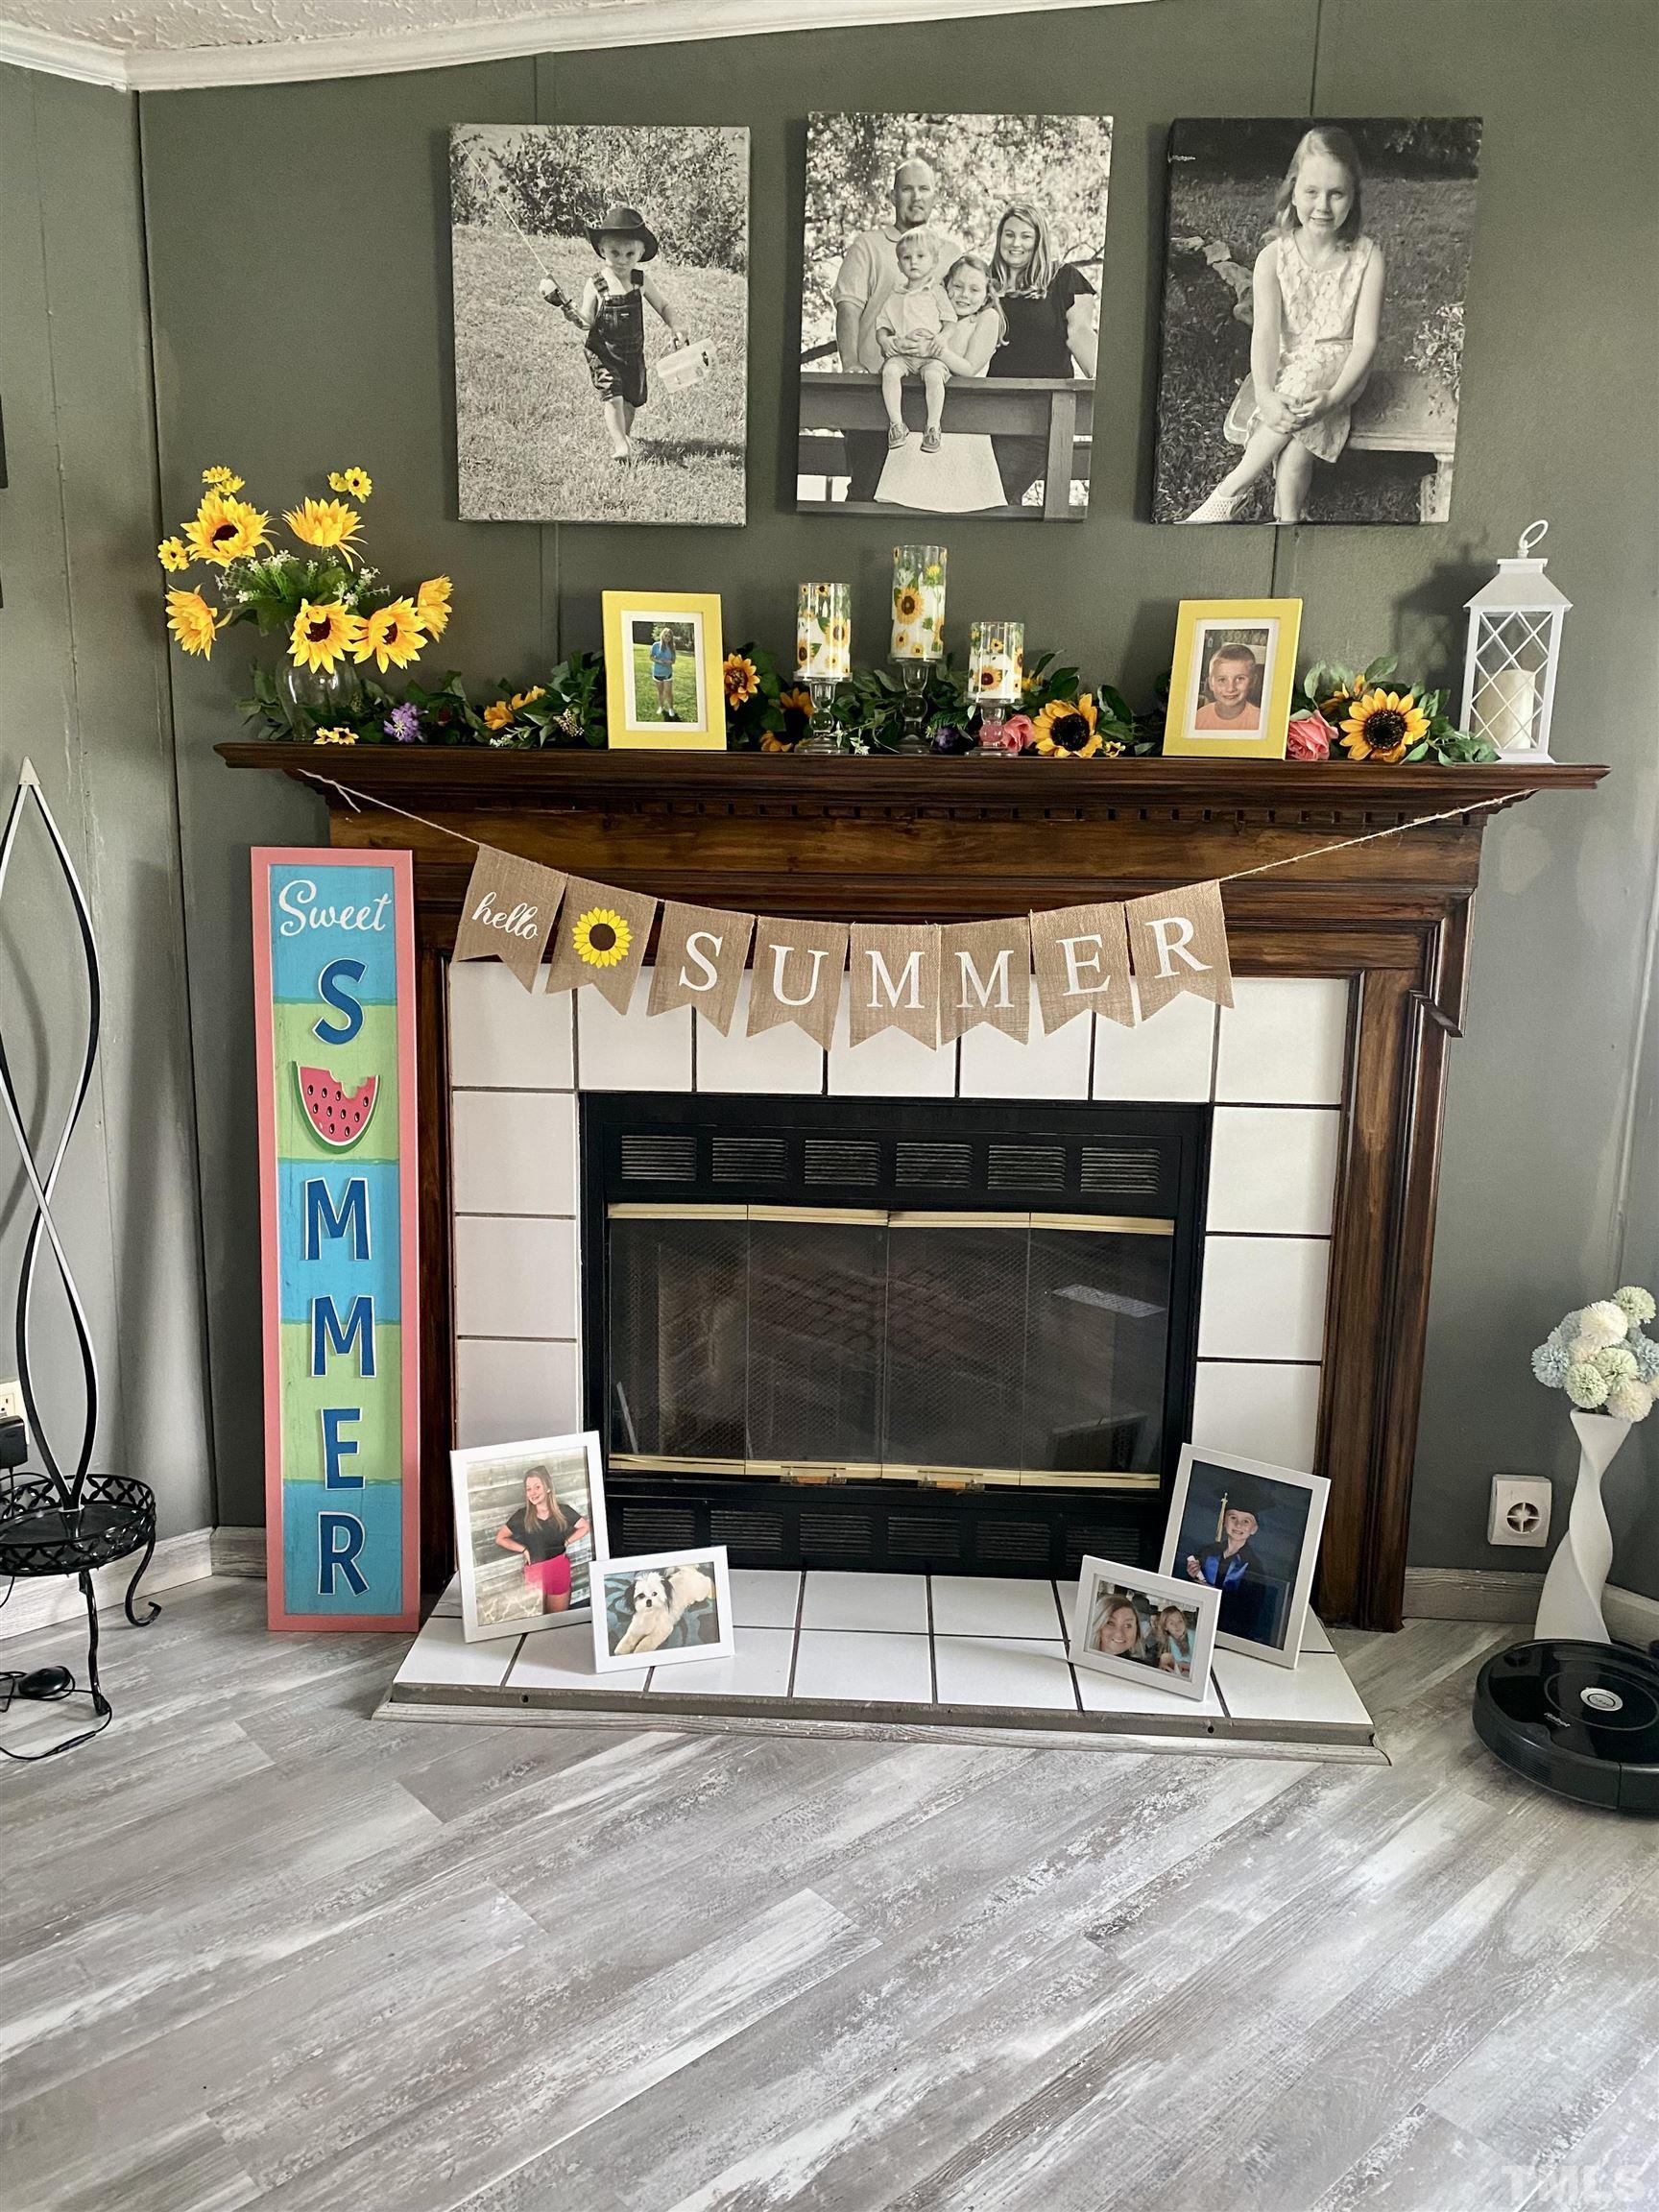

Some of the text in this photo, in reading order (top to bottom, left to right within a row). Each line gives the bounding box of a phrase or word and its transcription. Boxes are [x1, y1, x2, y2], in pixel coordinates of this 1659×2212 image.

[278, 879, 392, 937] Sweet
[471, 889, 1213, 1011] hello SUMMER
